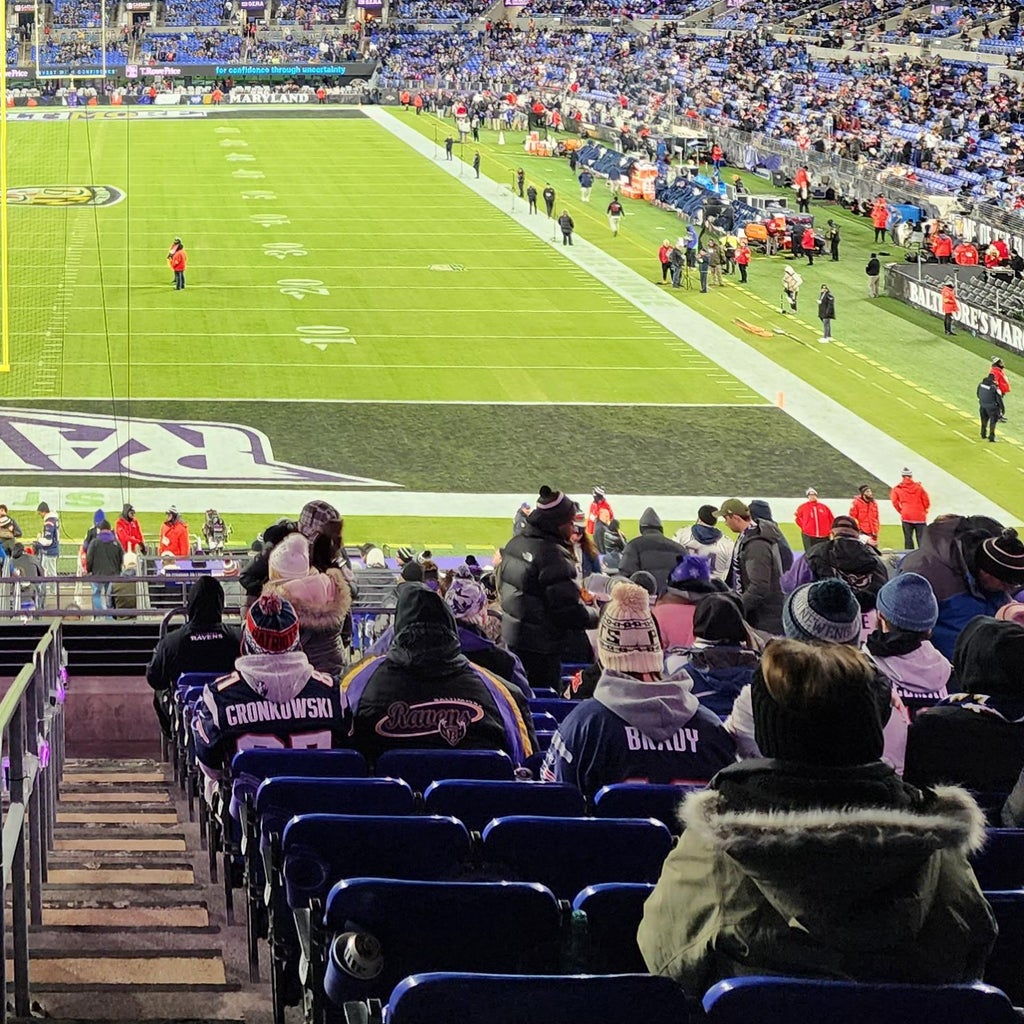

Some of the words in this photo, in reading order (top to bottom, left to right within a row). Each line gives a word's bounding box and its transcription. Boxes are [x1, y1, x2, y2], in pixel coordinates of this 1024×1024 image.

[215, 67, 227, 75] for
[228, 66, 270, 75] confidence
[271, 66, 301, 75] through
[302, 65, 346, 75] uncertainty
[229, 93, 310, 104] MARYLAND
[277, 278, 330, 295] 20
[908, 280, 989, 336] BALTIORE'S
[296, 326, 357, 345] 10
[190, 633, 224, 642] RAVENS
[387, 700, 472, 731] Ravens
